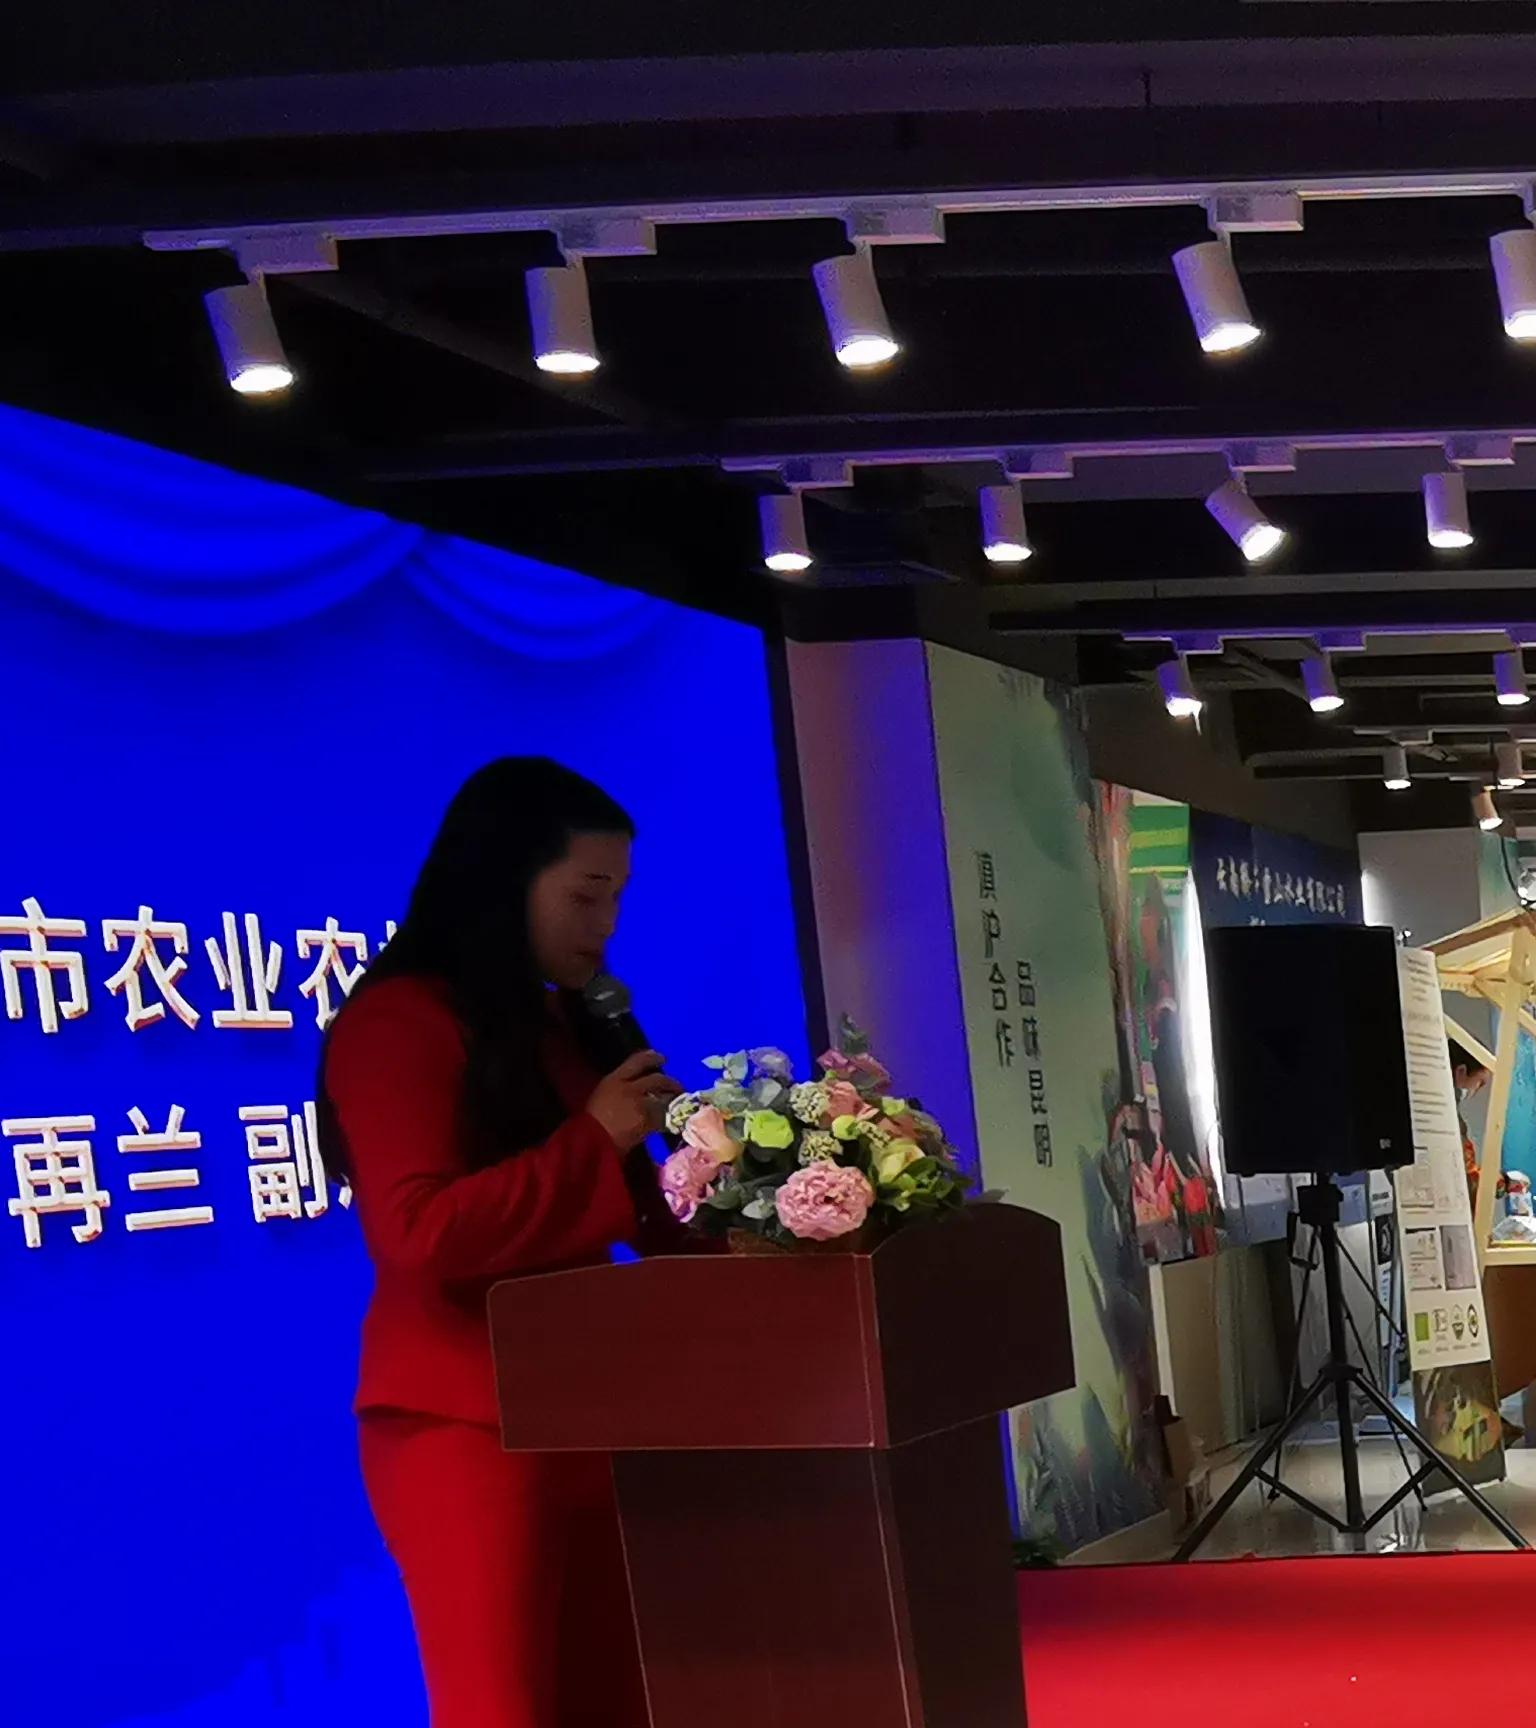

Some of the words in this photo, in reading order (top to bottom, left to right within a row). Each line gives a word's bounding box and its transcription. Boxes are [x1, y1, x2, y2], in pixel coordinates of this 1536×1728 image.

[0, 896, 397, 1034] 市农业农
[1, 1103, 214, 1248] 再兰
[238, 1100, 353, 1223] 副
